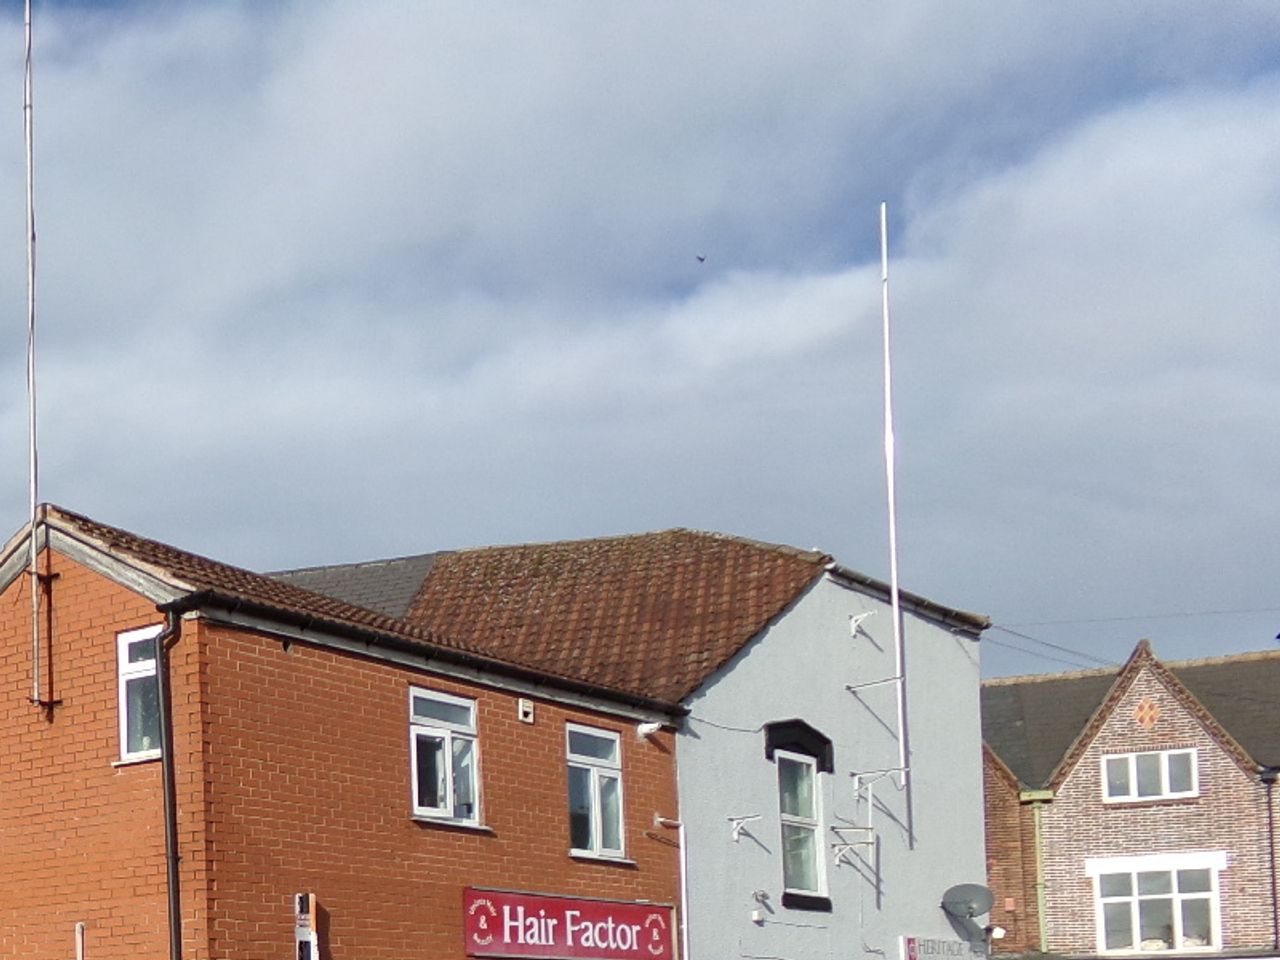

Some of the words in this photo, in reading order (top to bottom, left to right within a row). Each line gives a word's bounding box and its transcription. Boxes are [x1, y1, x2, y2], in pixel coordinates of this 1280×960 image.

[479, 914, 488, 929] &
[502, 905, 558, 946] Hair
[564, 910, 641, 951] Factor
